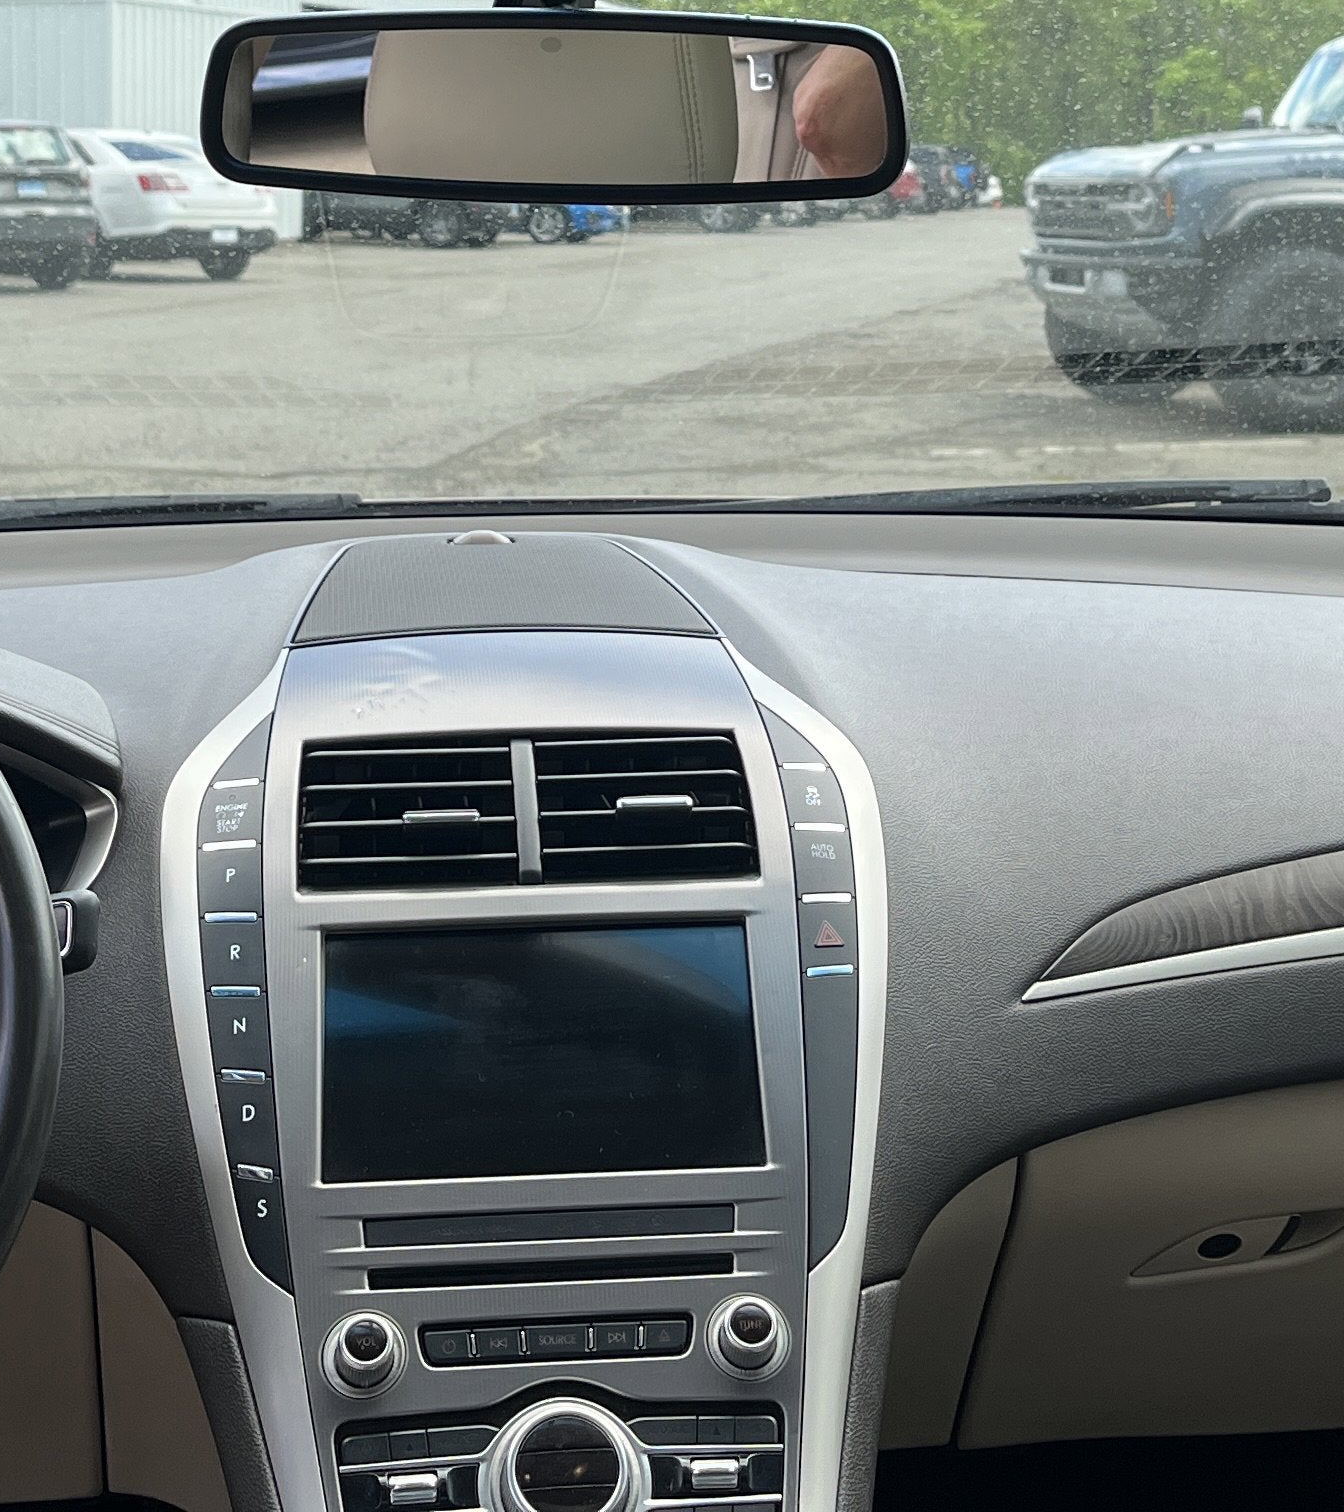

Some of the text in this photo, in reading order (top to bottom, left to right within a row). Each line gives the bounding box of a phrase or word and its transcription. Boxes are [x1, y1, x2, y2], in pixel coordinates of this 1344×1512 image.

[214, 802, 249, 813] ENGINE
[215, 824, 239, 834] STOP
[216, 818, 241, 827] START
[810, 843, 835, 853] AUTO
[811, 850, 836, 860] HOLD
[225, 867, 236, 883] P
[230, 944, 241, 961] R
[233, 1017, 247, 1035] N
[242, 1104, 256, 1122] D
[257, 1199, 268, 1218] S
[356, 1335, 377, 1348] VOL
[536, 1333, 577, 1346] SOURCE
